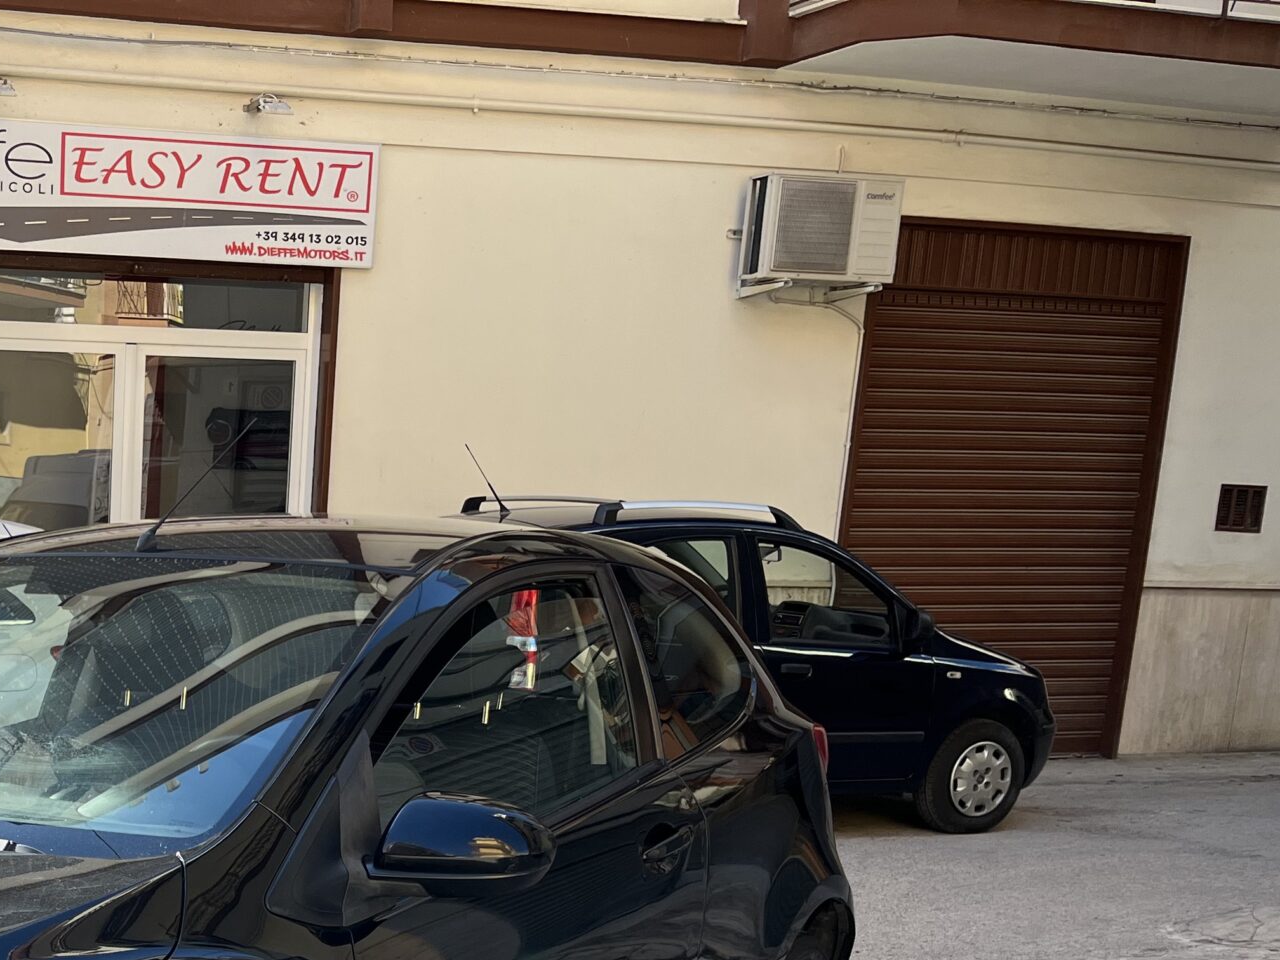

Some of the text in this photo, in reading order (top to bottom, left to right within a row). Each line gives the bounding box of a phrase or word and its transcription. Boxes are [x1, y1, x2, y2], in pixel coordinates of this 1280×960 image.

[72, 147, 203, 189] EASY
[255, 230, 367, 247] +39 349 13 02 015
